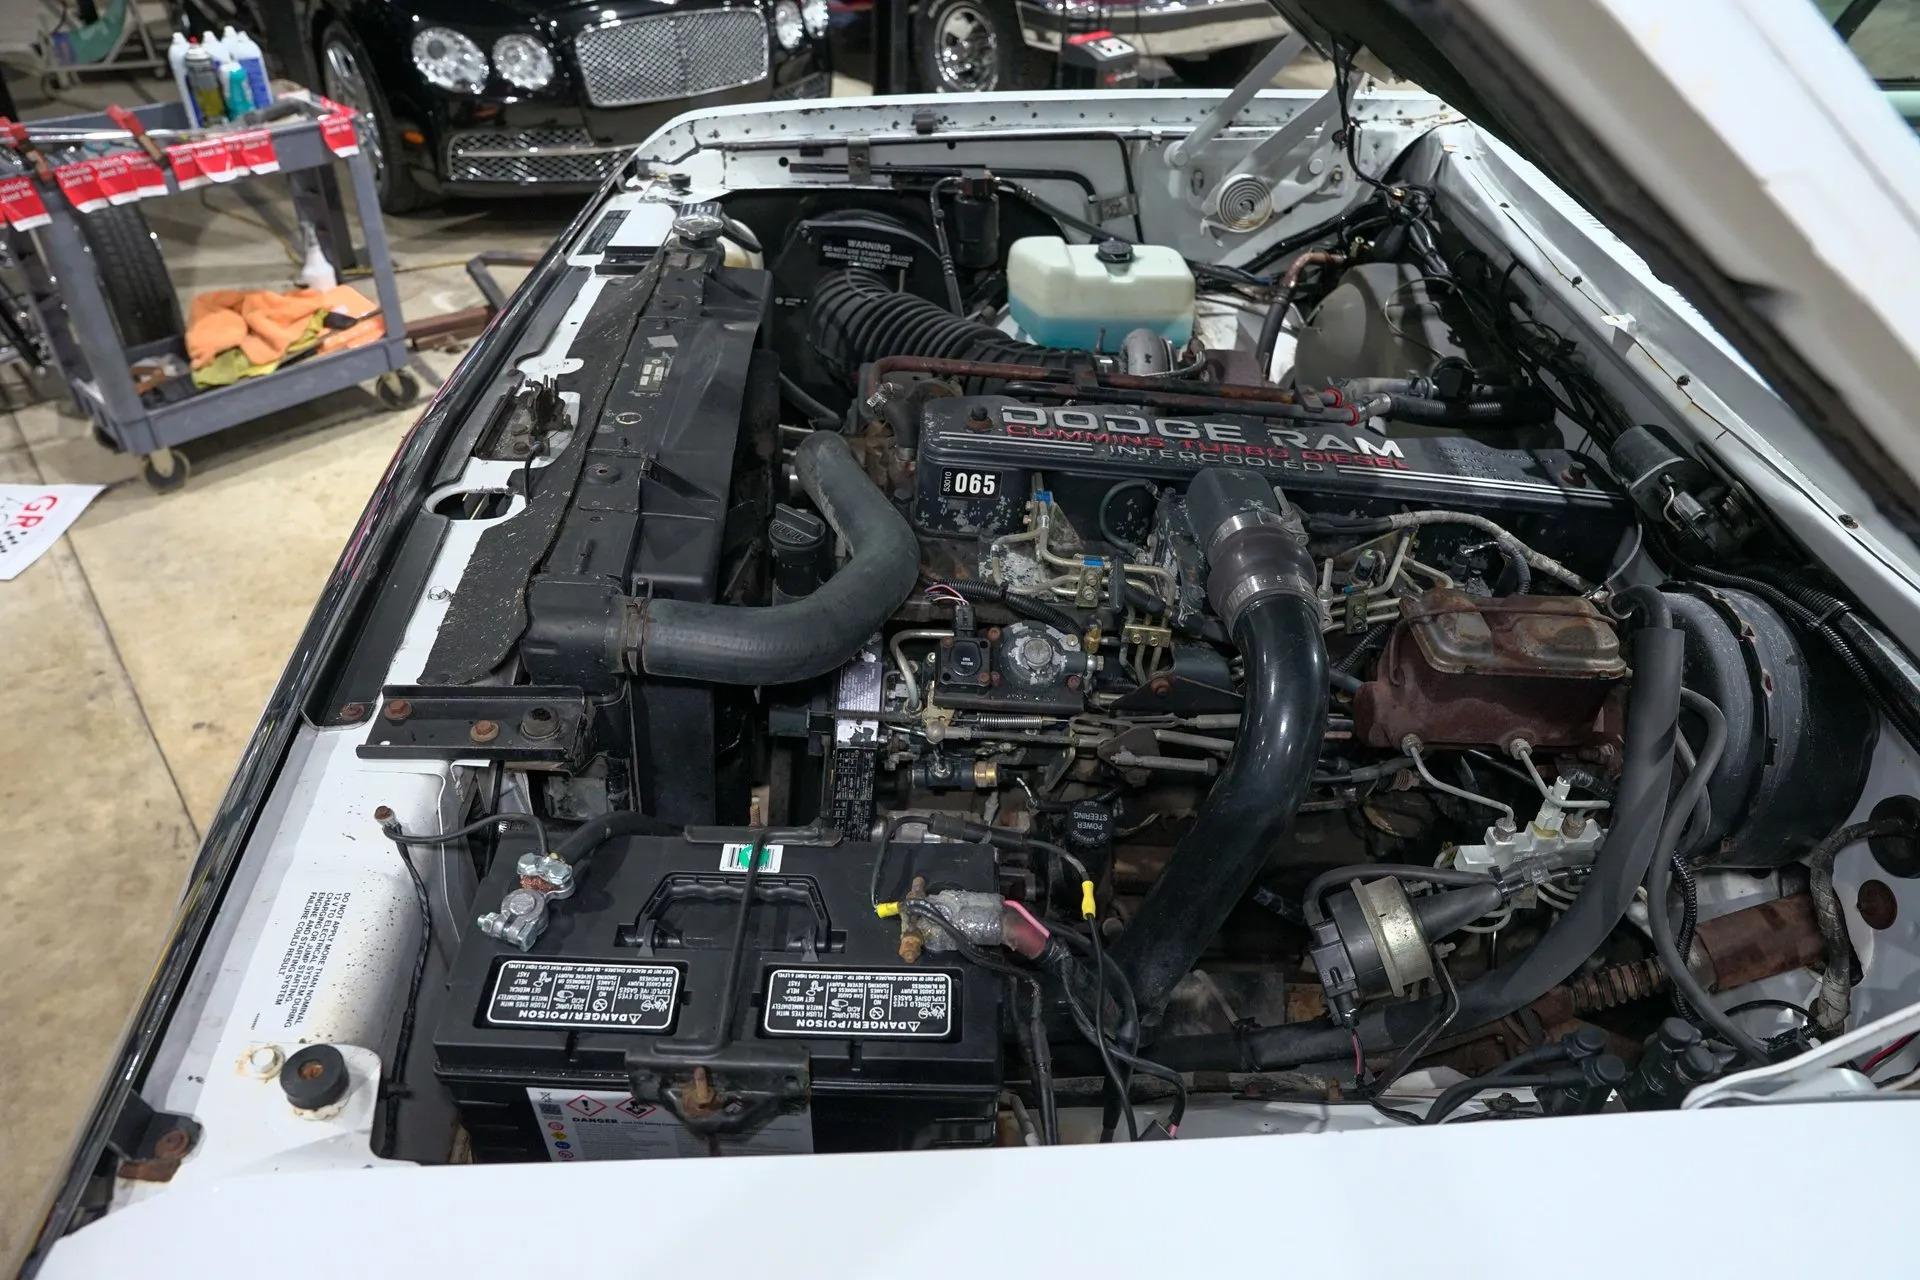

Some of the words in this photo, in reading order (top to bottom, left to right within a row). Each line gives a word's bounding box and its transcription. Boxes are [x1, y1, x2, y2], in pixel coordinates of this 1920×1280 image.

[848, 240, 890, 252] WARNING
[860, 250, 892, 260] STARTING
[1002, 406, 1246, 442] DODGE
[1268, 428, 1404, 458] RAM
[1007, 423, 1164, 448] CUMMINS
[1184, 440, 1289, 461] TURBO
[1302, 450, 1410, 470] DIESEL
[1110, 446, 1324, 472] INTERCOOLED
[955, 472, 996, 494] 065
[8, 496, 58, 528] GR
[1074, 812, 1108, 822] STEERING
[1078, 822, 1102, 830] POWER
[300, 892, 318, 920] FAILURE
[310, 892, 326, 918] ENGINE
[342, 893, 351, 903] DO
[314, 892, 334, 929] CHARGING
[328, 909, 336, 918] TO
[336, 904, 346, 918] NOT
[290, 922, 305, 946] COULD
[304, 920, 314, 934] AND
[310, 931, 318, 942] OR
[328, 921, 340, 942] APPLY
[310, 920, 332, 964] ELECTRICAL
[278, 948, 294, 975] RESULT
[288, 936, 308, 972] STARTING
[302, 944, 312, 963] JUMP
[318, 944, 332, 965] MORE
[296, 966, 314, 996] SYSTEM
[310, 968, 323, 988] THAN
[275, 974, 292, 1005] SYSTEM
[284, 998, 302, 1028] DURING
[294, 990, 314, 1025] NOMINAL
[519, 1010, 627, 1021] DANGER/POISON
[797, 1020, 906, 1029] DANGER/POISON
